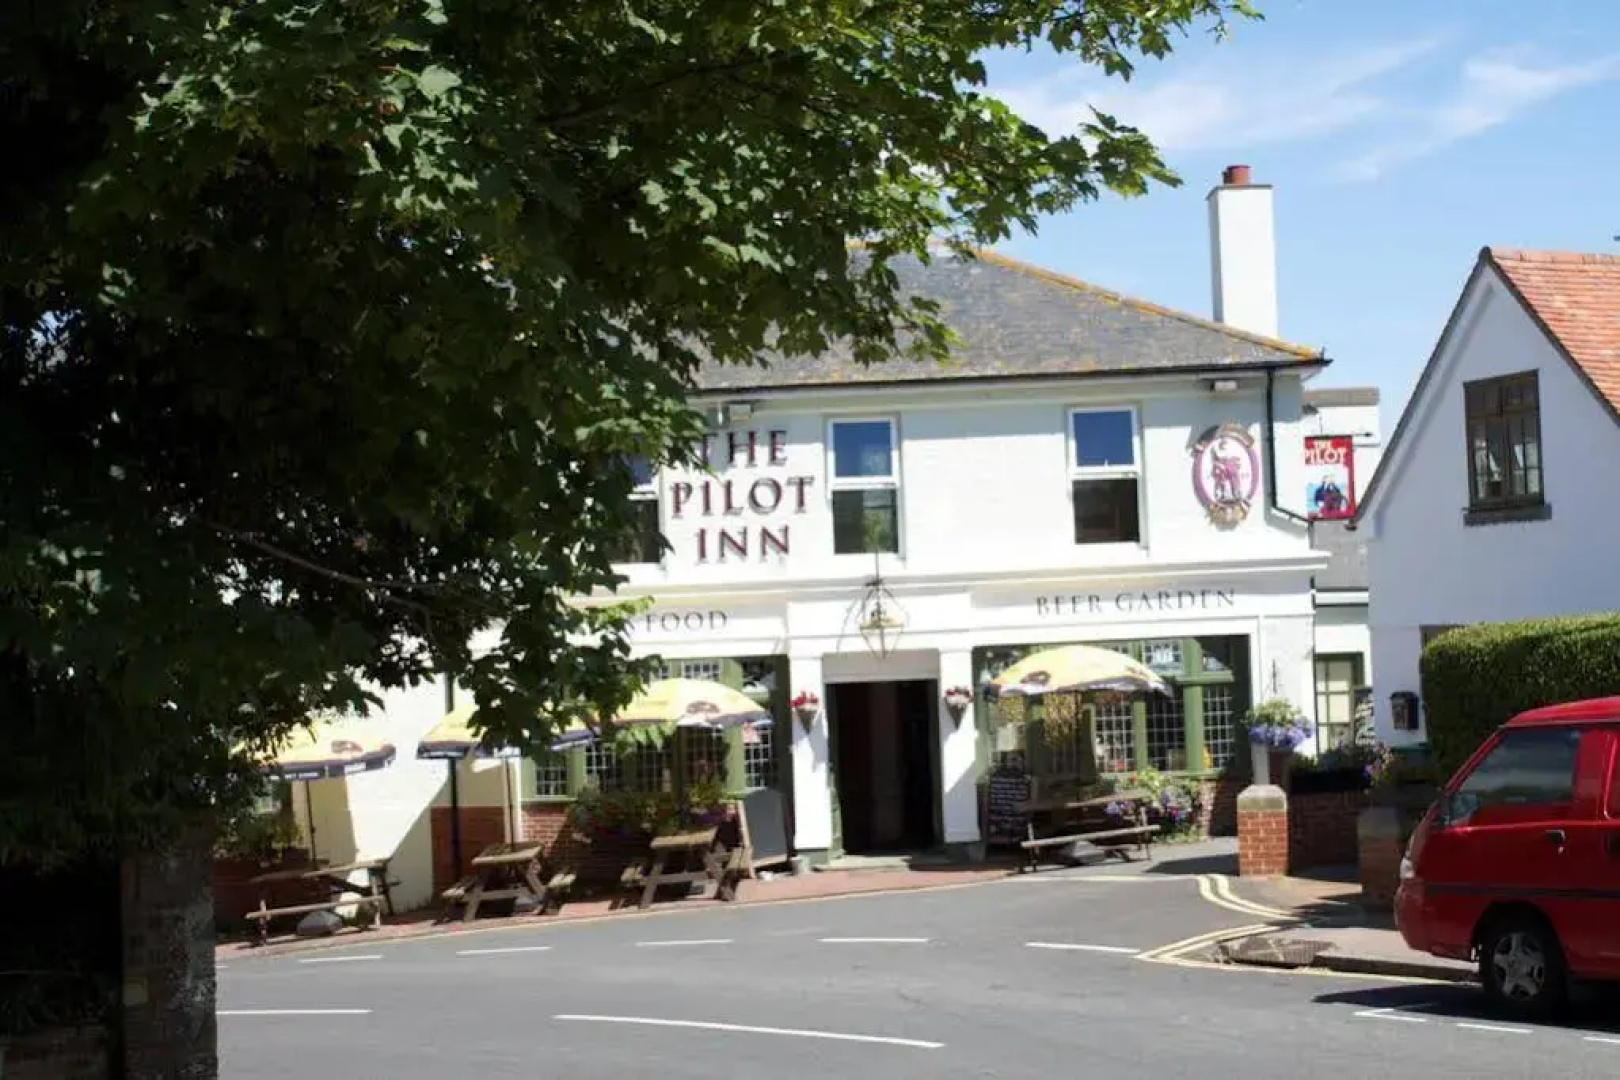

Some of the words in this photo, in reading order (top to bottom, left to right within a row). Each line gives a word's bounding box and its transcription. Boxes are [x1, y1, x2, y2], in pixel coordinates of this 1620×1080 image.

[670, 475, 815, 519] PILOT
[695, 524, 790, 565] INN
[1035, 594, 1102, 616] BEER
[1114, 587, 1236, 613] GARDEN
[645, 610, 728, 633] FOOD
